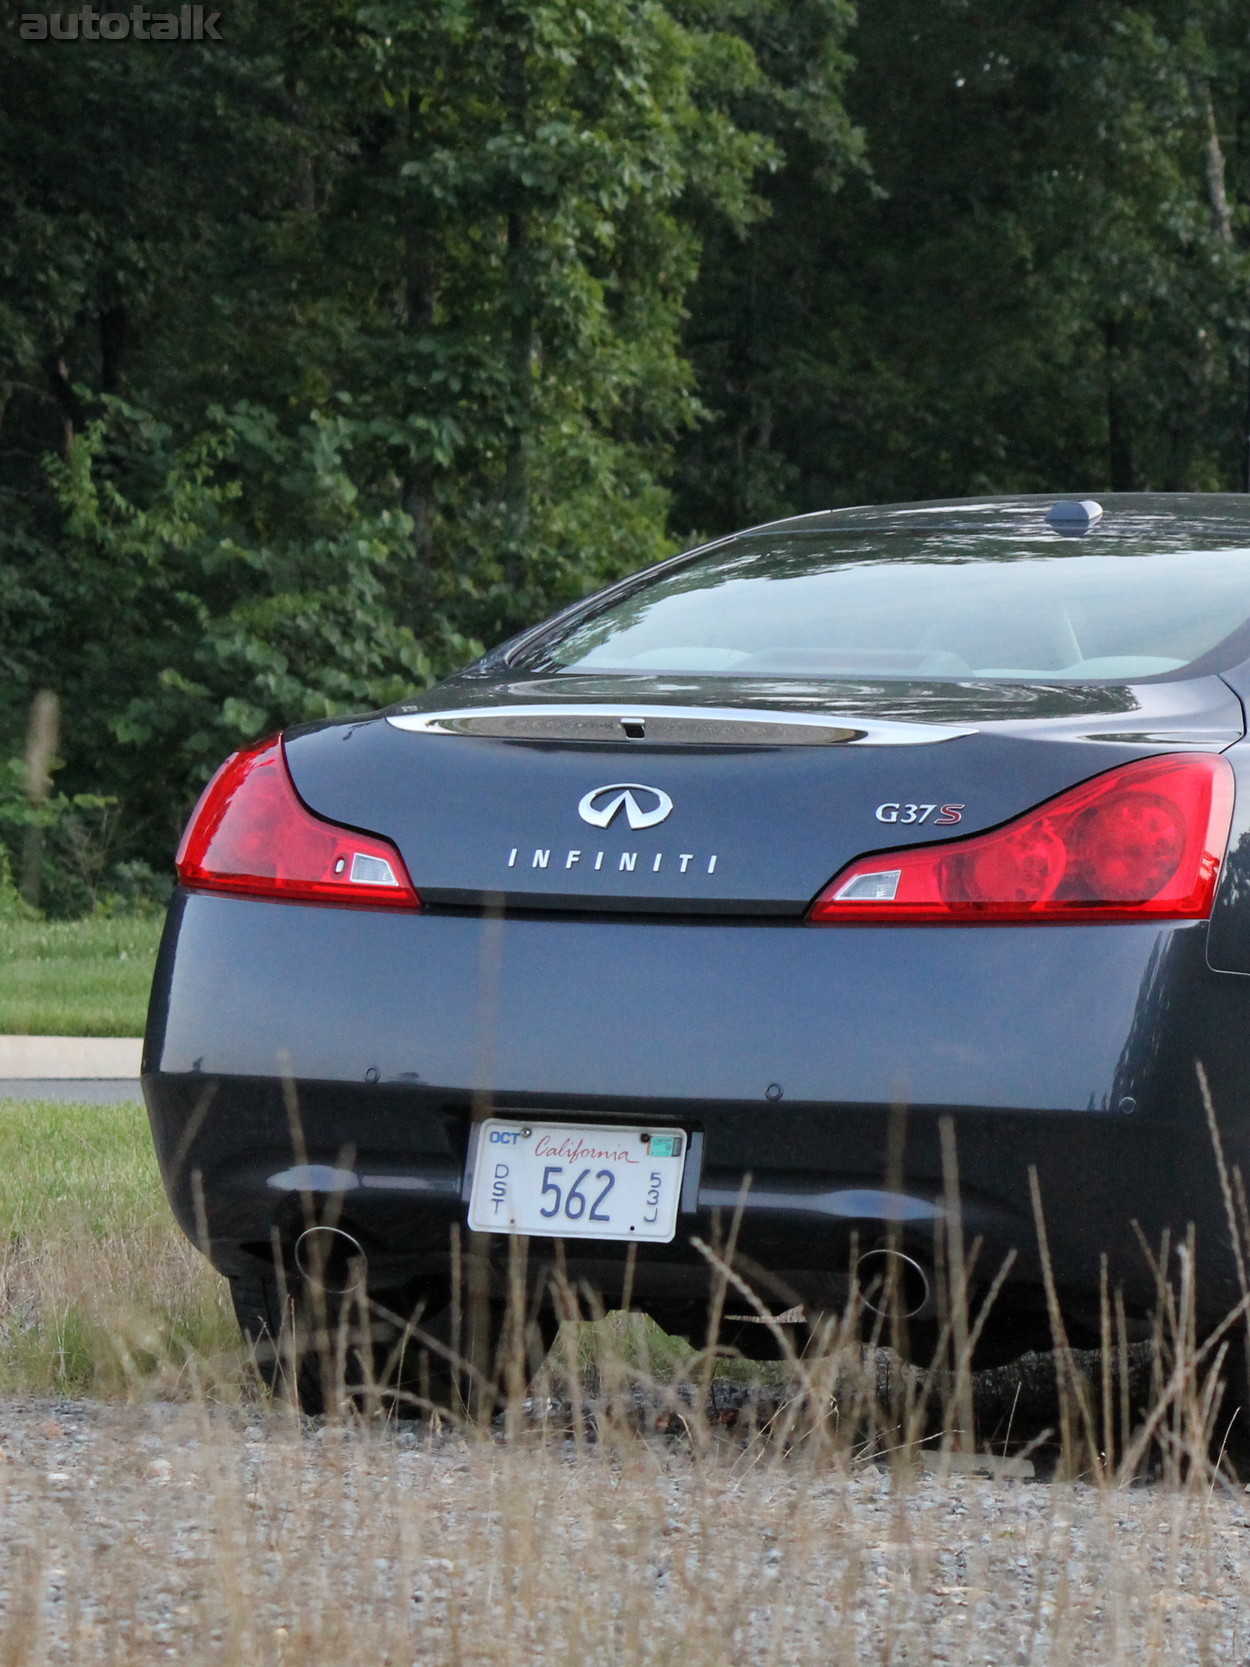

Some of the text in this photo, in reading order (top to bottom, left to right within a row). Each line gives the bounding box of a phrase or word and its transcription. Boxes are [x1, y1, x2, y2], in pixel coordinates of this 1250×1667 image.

[875, 802, 965, 825] G37S
[507, 848, 718, 874] INFINITI
[489, 1131, 521, 1145] OCT
[534, 1135, 640, 1164] California
[539, 1166, 616, 1222] 562
